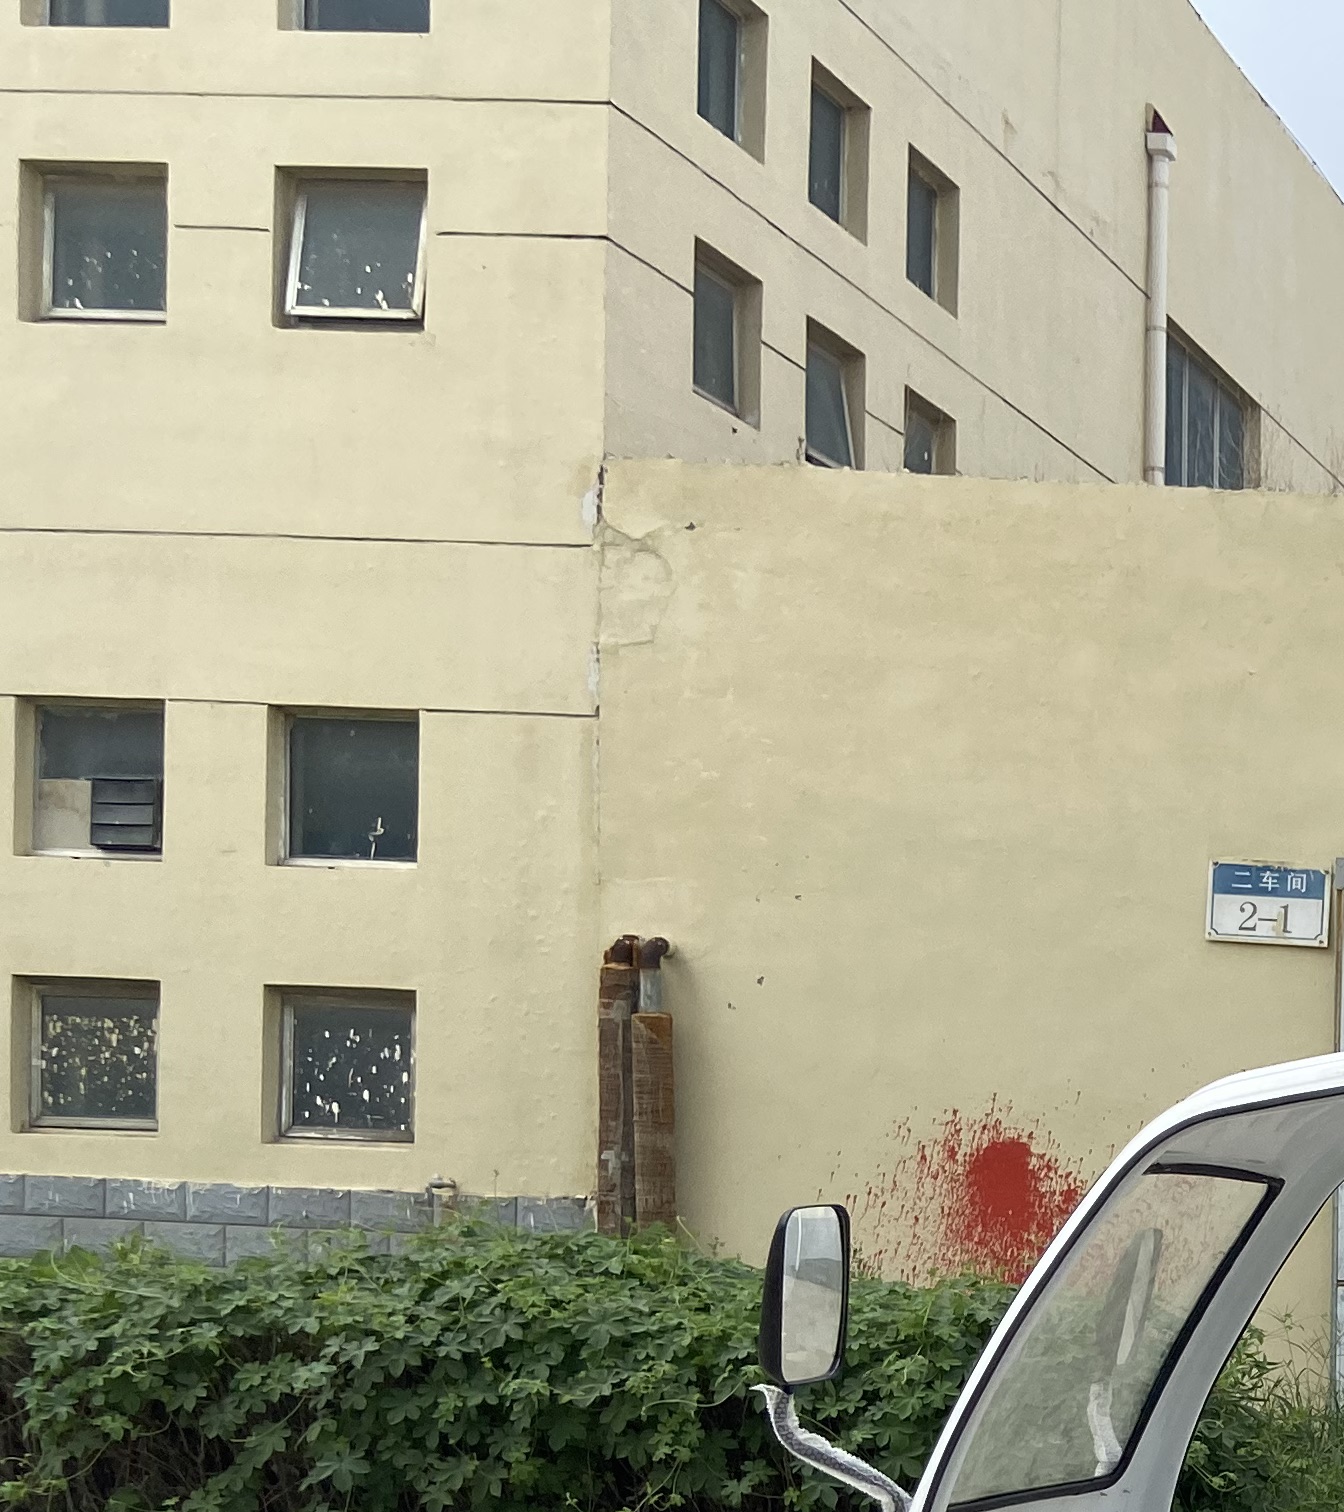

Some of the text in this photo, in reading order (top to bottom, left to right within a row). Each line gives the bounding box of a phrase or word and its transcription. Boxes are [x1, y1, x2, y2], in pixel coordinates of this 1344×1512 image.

[1231, 870, 1308, 893] 二车间
[1238, 901, 1293, 934] 2-1
